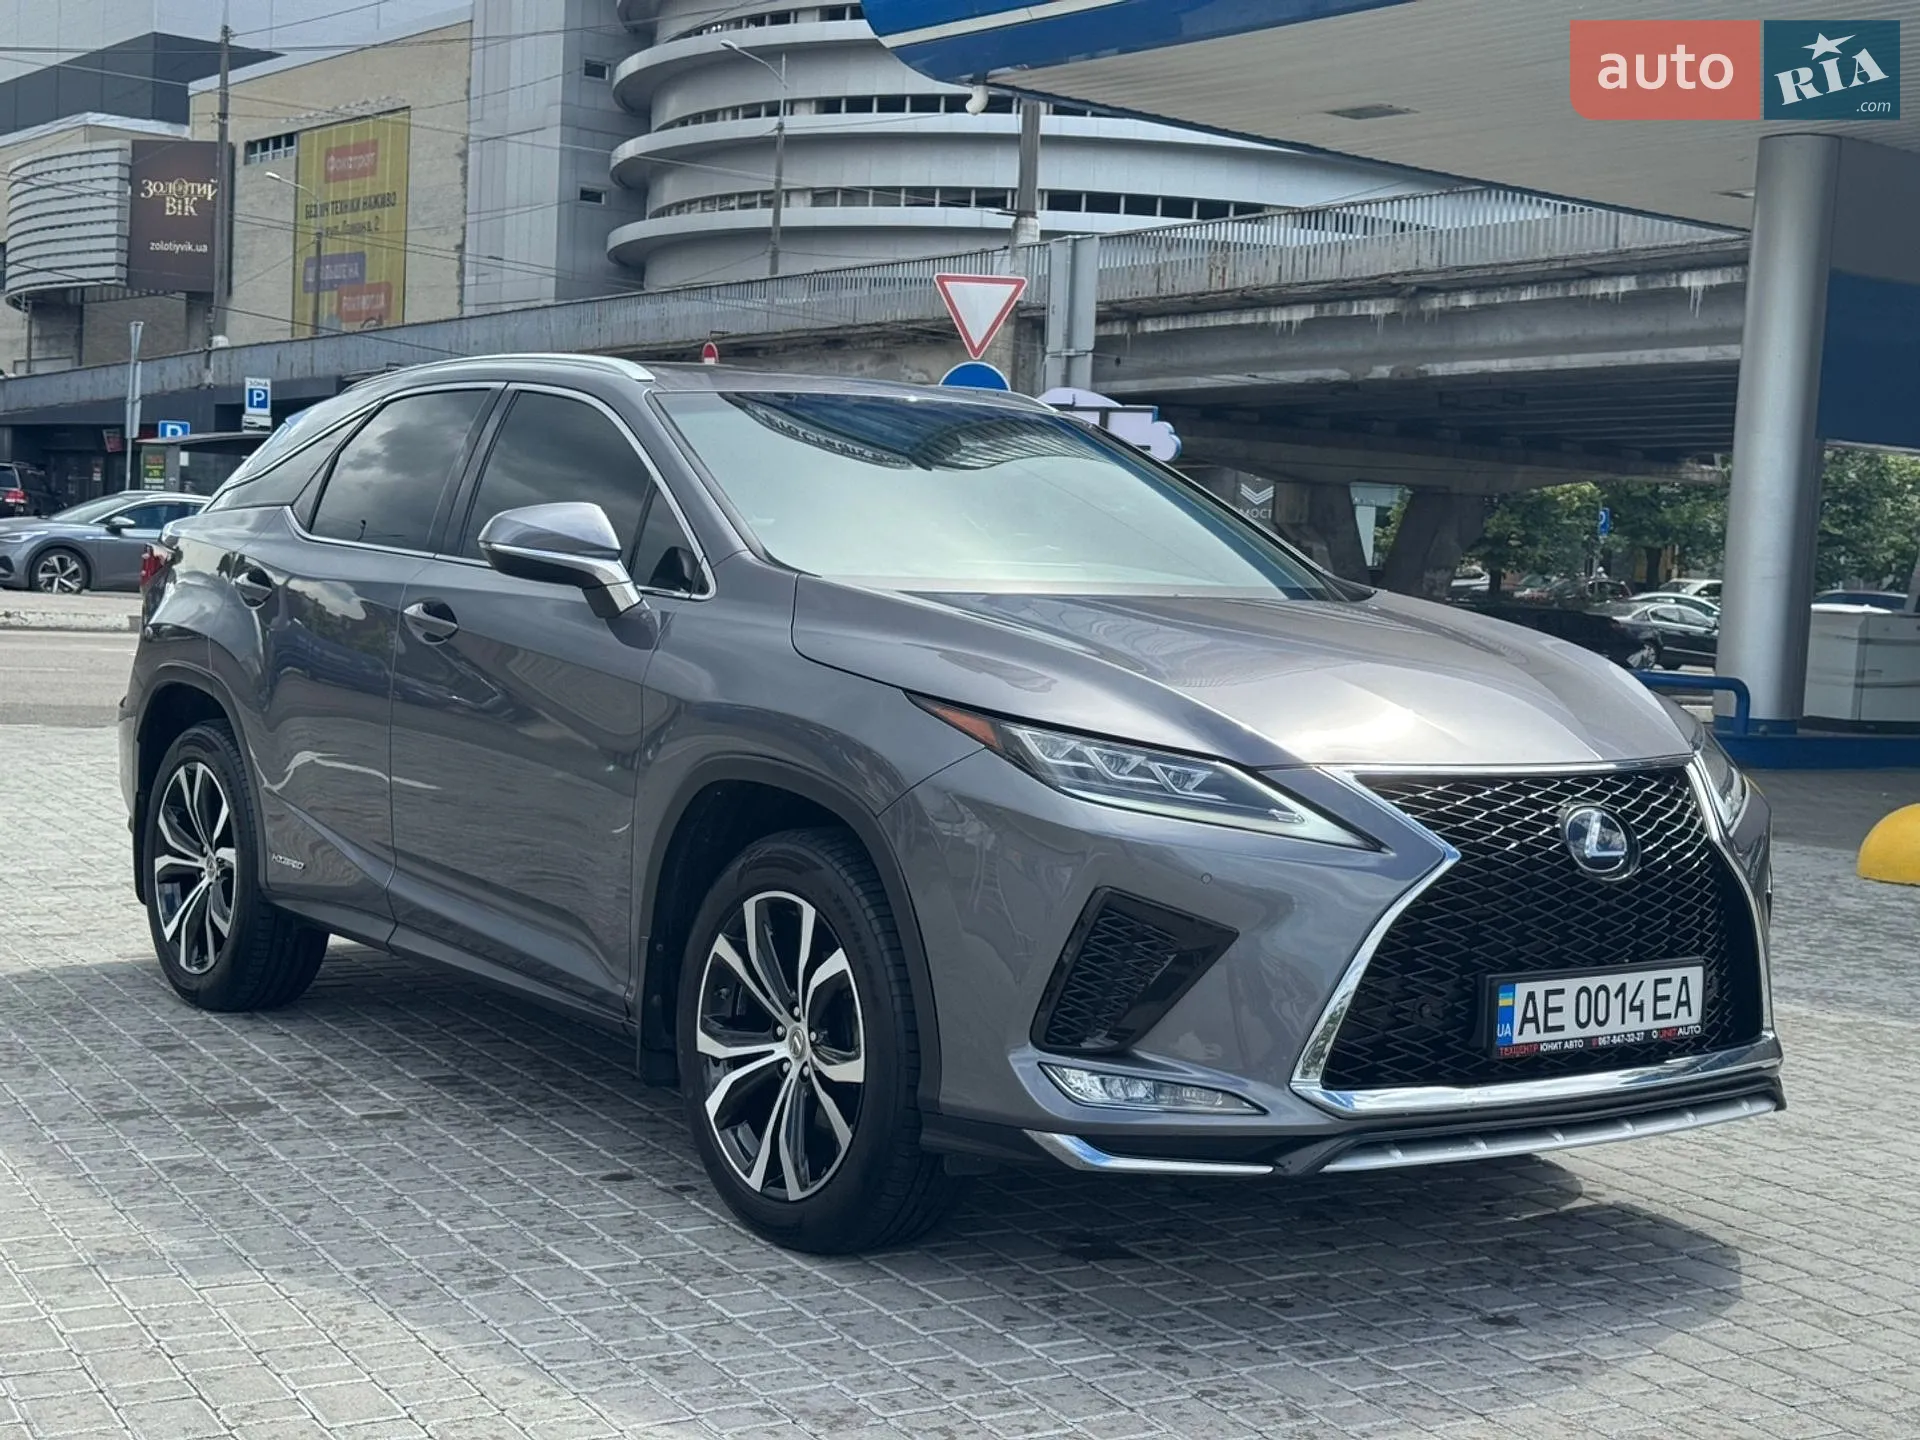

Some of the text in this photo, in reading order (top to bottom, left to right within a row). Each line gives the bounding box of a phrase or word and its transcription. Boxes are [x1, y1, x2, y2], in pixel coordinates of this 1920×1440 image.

[149, 240, 208, 254] zolotiyvik.ua
[253, 390, 265, 407] P
[1518, 976, 1692, 1036] AE 0014 EA
[1497, 1023, 1512, 1037] UA
[1563, 1039, 1584, 1050] АВТО
